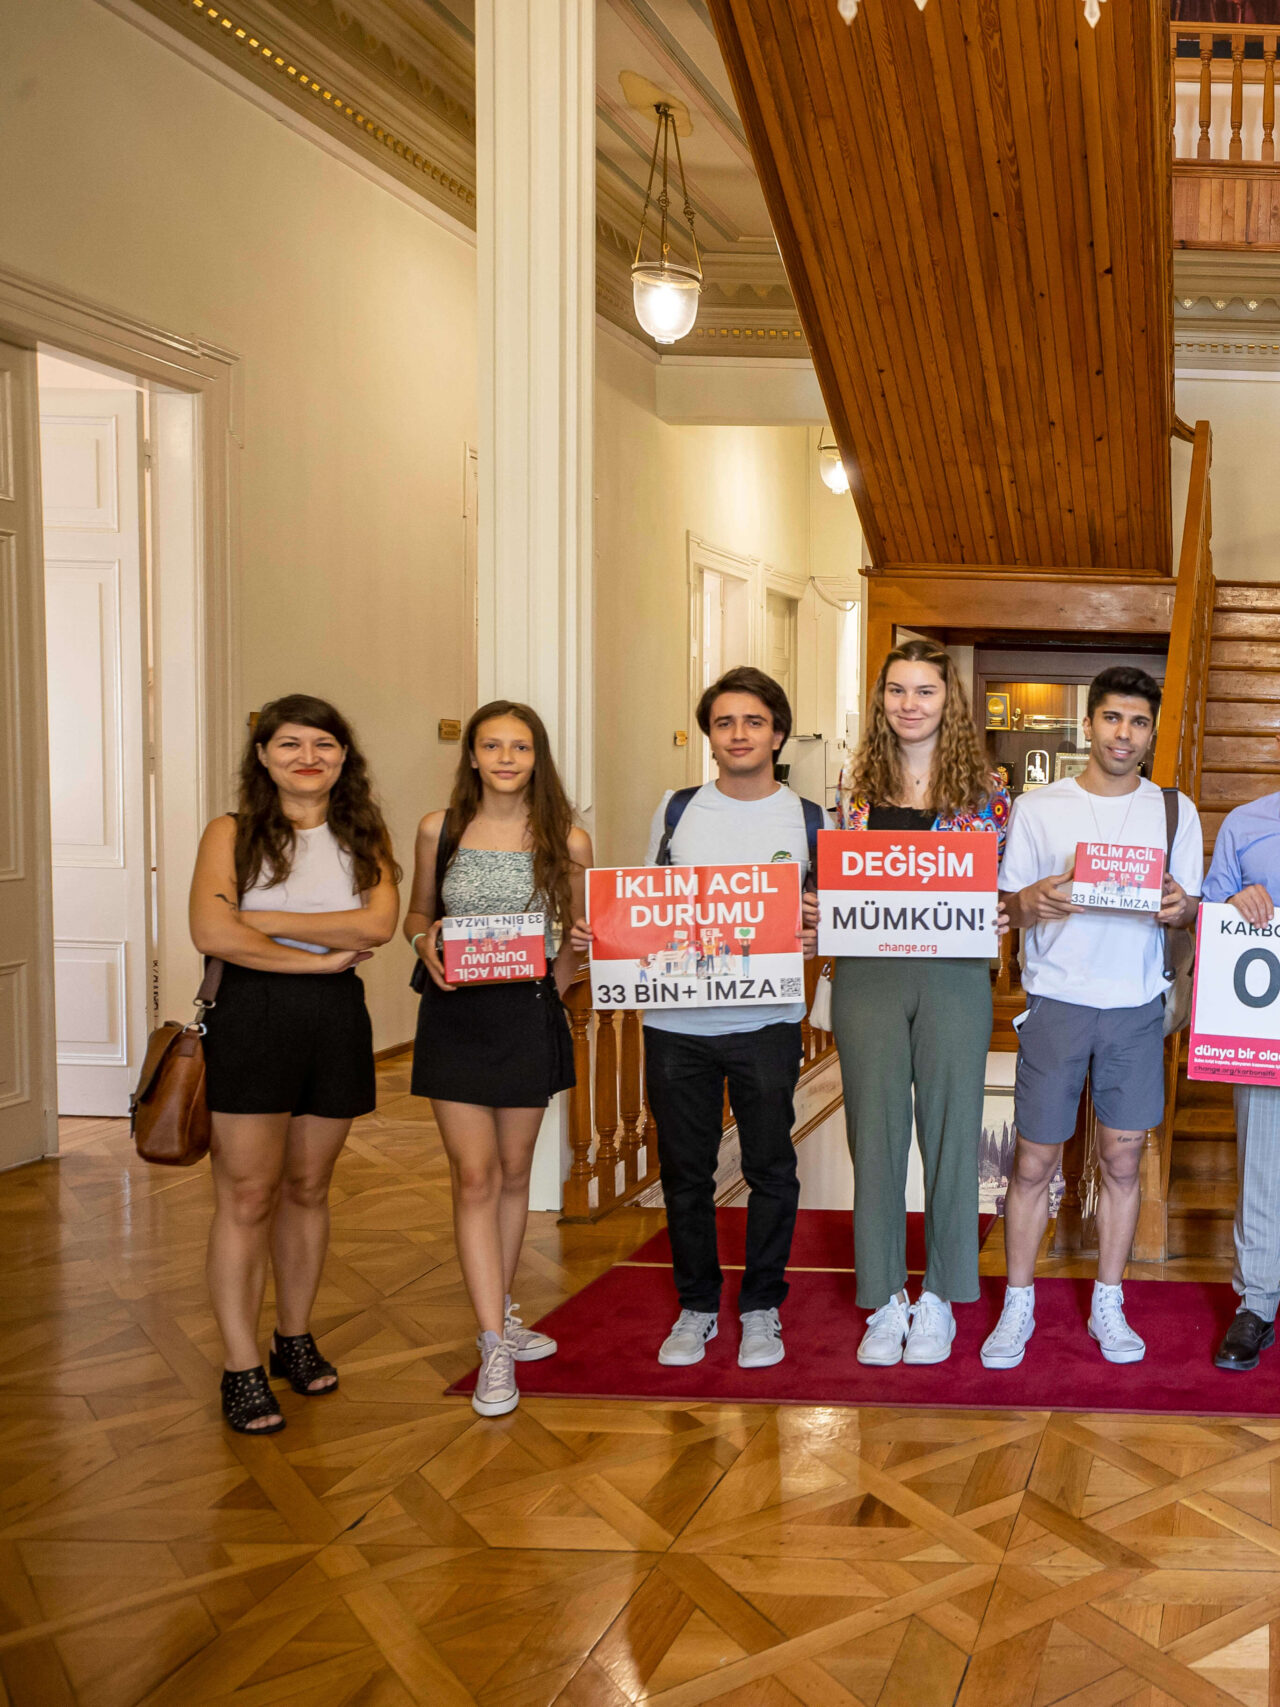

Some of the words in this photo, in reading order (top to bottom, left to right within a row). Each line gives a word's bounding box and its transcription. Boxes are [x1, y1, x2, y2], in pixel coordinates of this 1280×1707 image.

[1087, 843, 1123, 858] İKLİM
[1126, 847, 1157, 862] ACİL
[841, 845, 974, 884] DEĞİŞİM
[1091, 858, 1150, 874] DURUMU
[616, 869, 698, 899] İKLİM
[707, 865, 778, 896] ACİL
[1071, 893, 1085, 904] 33
[1120, 894, 1150, 909] İMZA
[528, 914, 543, 924] 33
[630, 900, 765, 928] DURUMU
[832, 900, 985, 932] MÜMKÜN!
[878, 942, 938, 954] change.org
[461, 950, 527, 965] DURUMU
[454, 966, 490, 982] ACİL
[493, 964, 535, 980] İKLİM
[597, 984, 626, 1003] 33
[706, 975, 777, 1000] İMZA
[1194, 1045, 1235, 1060] dünya
[1238, 1047, 1256, 1059] bir
